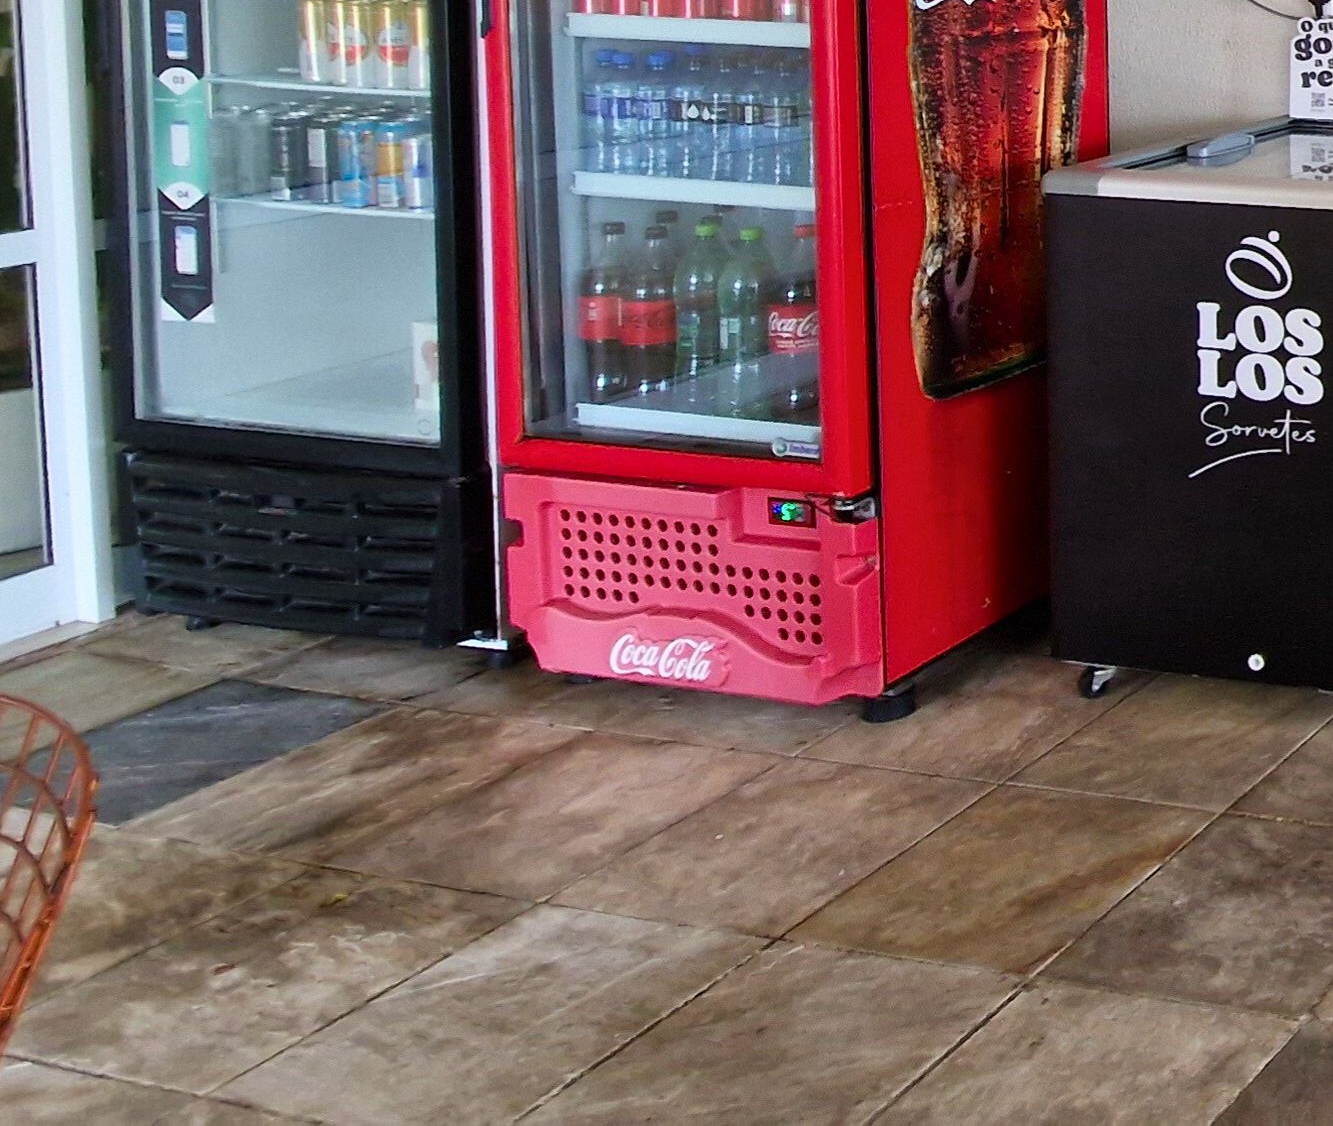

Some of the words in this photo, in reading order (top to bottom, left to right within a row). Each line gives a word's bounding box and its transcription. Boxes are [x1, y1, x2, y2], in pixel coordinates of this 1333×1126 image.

[1314, 58, 1323, 67] a
[172, 75, 185, 84] 03
[177, 189, 190, 199] 04
[1196, 301, 1324, 356] LOS
[1197, 348, 1324, 405] LOS
[1200, 401, 1316, 455] Sorvetes
